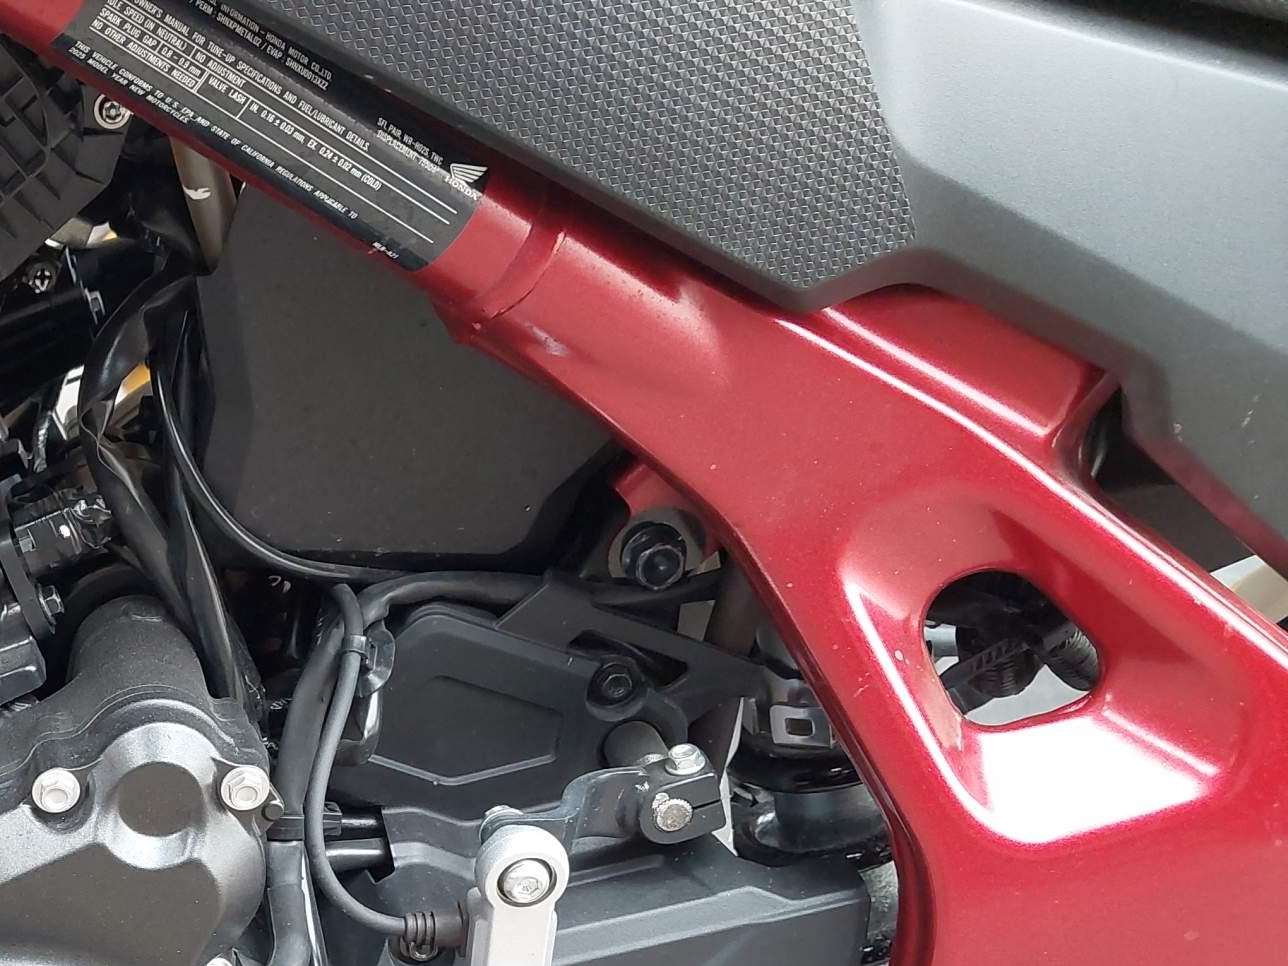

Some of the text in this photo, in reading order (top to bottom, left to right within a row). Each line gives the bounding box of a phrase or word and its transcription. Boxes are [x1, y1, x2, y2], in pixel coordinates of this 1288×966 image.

[99, 7, 157, 46] SPARK PLUG GAP
[106, 0, 124, 10] DLE
[123, 6, 145, 24] SPEED
[155, 26, 187, 50] NEUTRAL)
[194, 0, 213, 14] PERM
[266, 44, 282, 59] EVAP
[91, 18, 196, 87] NO OTHER ADJUSTMENTS NEEDED
[160, 46, 173, 58] 0.8
[177, 56, 190, 69] 0.9
[187, 65, 201, 76] mm
[194, 51, 246, 87] NO ADJUSTMENT
[264, 31, 285, 50] HONDA
[287, 46, 309, 65] MOTOR
[68, 46, 86, 59] 2025
[86, 57, 108, 74] MODEL
[111, 72, 128, 85] YEAR
[128, 83, 145, 95] NEW
[163, 13, 190, 36] MANUAL
[191, 31, 205, 46] FOR
[206, 40, 235, 63] TUNE-UP
[235, 60, 282, 94] SPECIFICATIONS
[282, 90, 297, 104] AND
[297, 99, 346, 135] FUEL/LUBRICANT
[208, 76, 246, 104] VALVE LASH
[74, 40, 91, 53] THIS
[91, 50, 118, 70] VEHICLE
[118, 68, 153, 91] CONFORMS
[153, 89, 164, 98] TO
[193, 115, 210, 126] AND
[210, 125, 230, 139] STATE
[230, 137, 241, 145] OF
[240, 144, 274, 167] CALIFORNIA
[274, 165, 314, 191] REGULATIONS
[313, 189, 348, 213] APPLICABLE
[347, 210, 358, 219] TO
[260, 109, 275, 122] 0.16
[279, 121, 294, 134] 0.03
[318, 146, 333, 159] 0.24
[337, 158, 352, 171] 0.02
[349, 167, 362, 178] mm
[360, 173, 382, 191] (COLD)
[430, 151, 443, 165] TWC
[444, 173, 481, 200] HONDA
